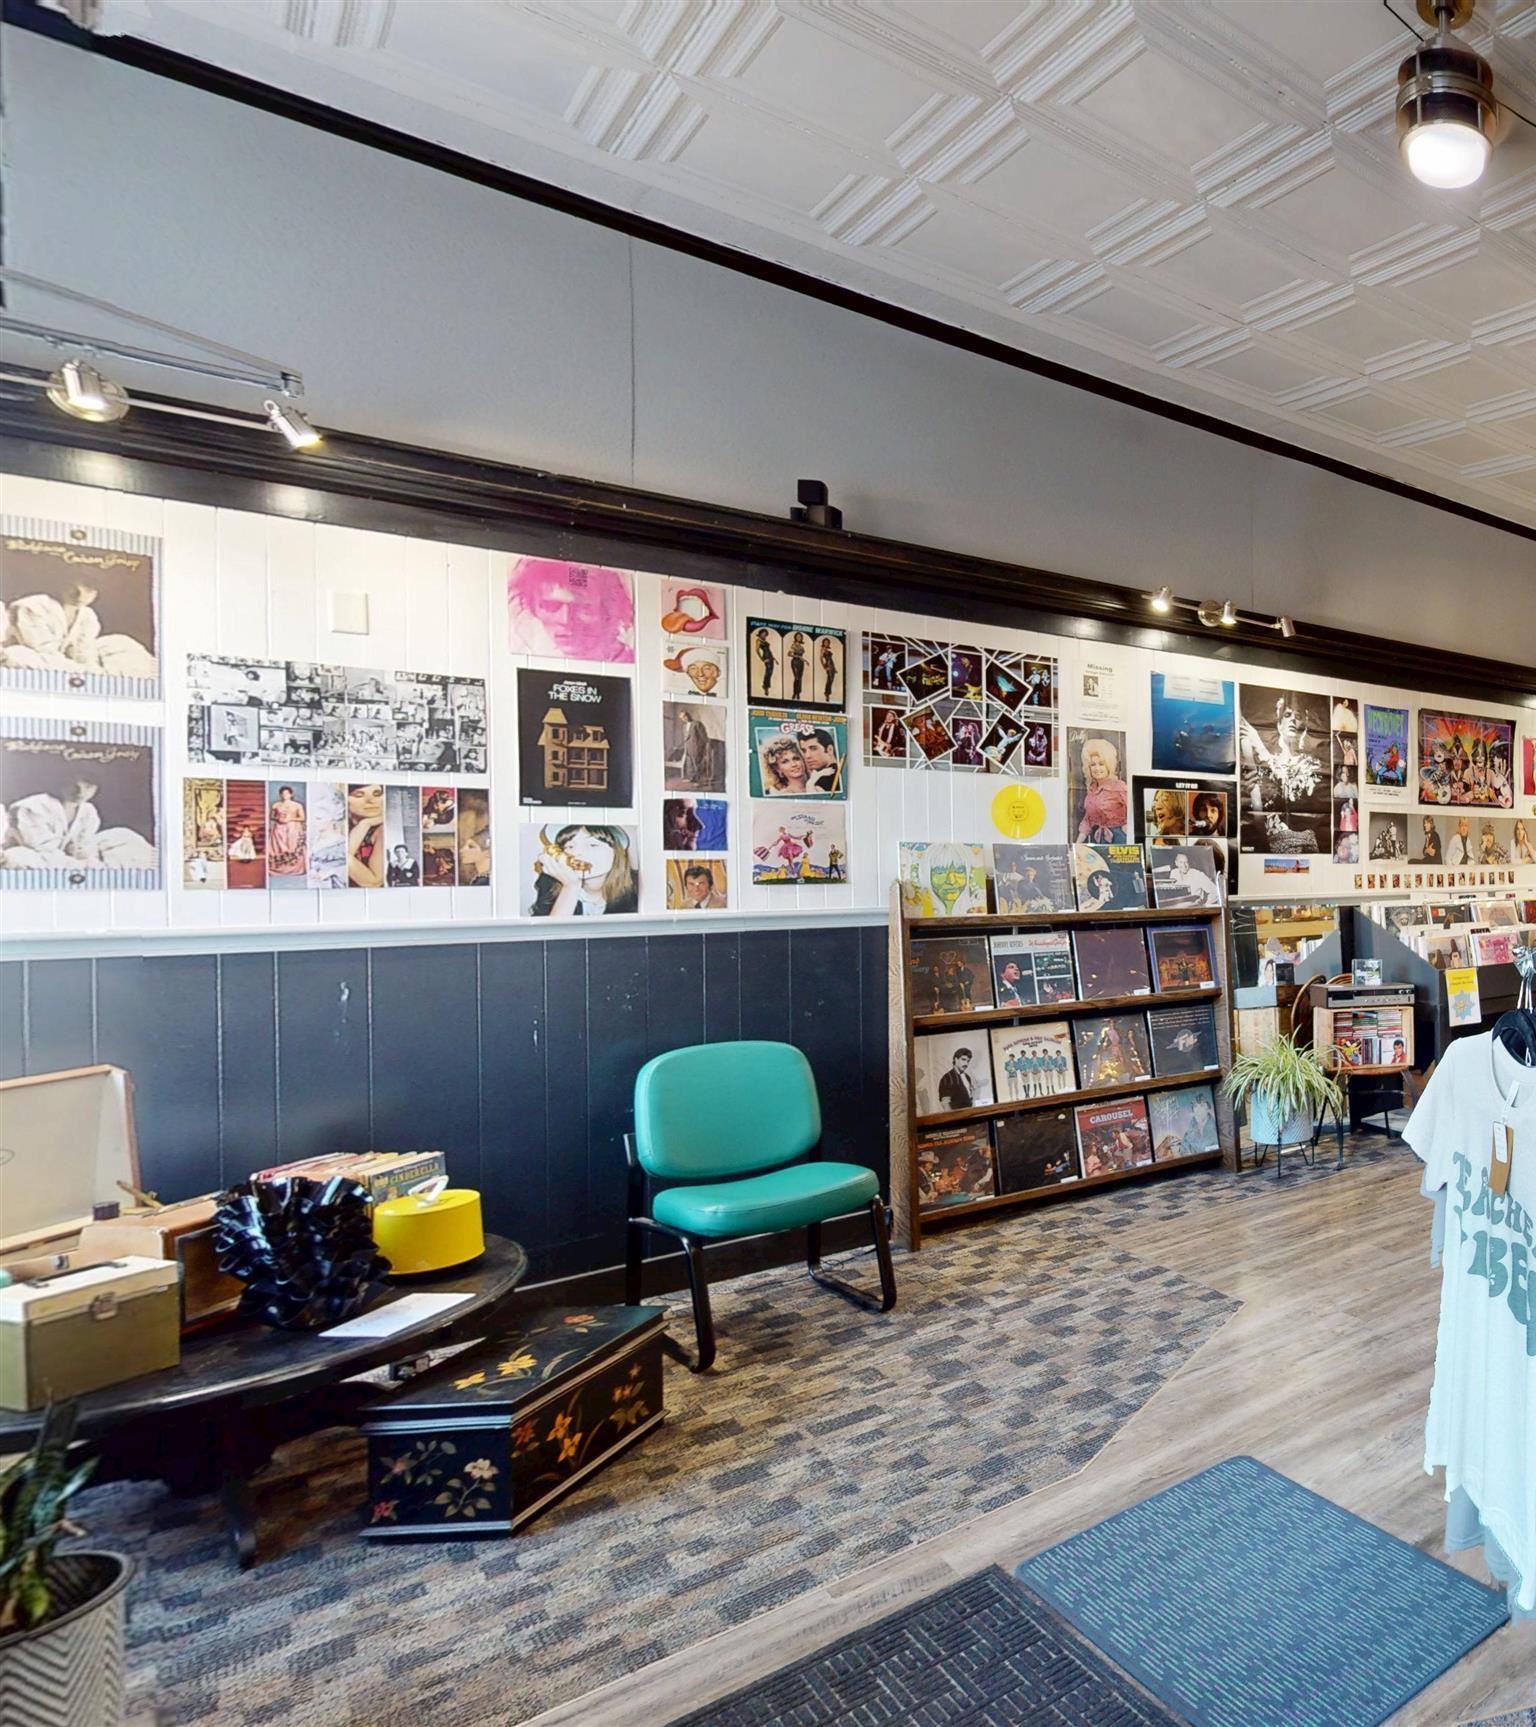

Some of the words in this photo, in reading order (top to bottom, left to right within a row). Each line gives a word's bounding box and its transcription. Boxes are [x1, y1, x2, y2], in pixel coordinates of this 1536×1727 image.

[1087, 664, 1112, 673] Missing
[553, 684, 586, 694] FOXES
[587, 687, 598, 695] IN
[548, 691, 568, 701] THE
[570, 693, 602, 703] SNOW
[1108, 846, 1139, 855] ELVIS
[1090, 1109, 1133, 1124] CAROUSEL
[390, 1162, 439, 1185] CINDERELLA
